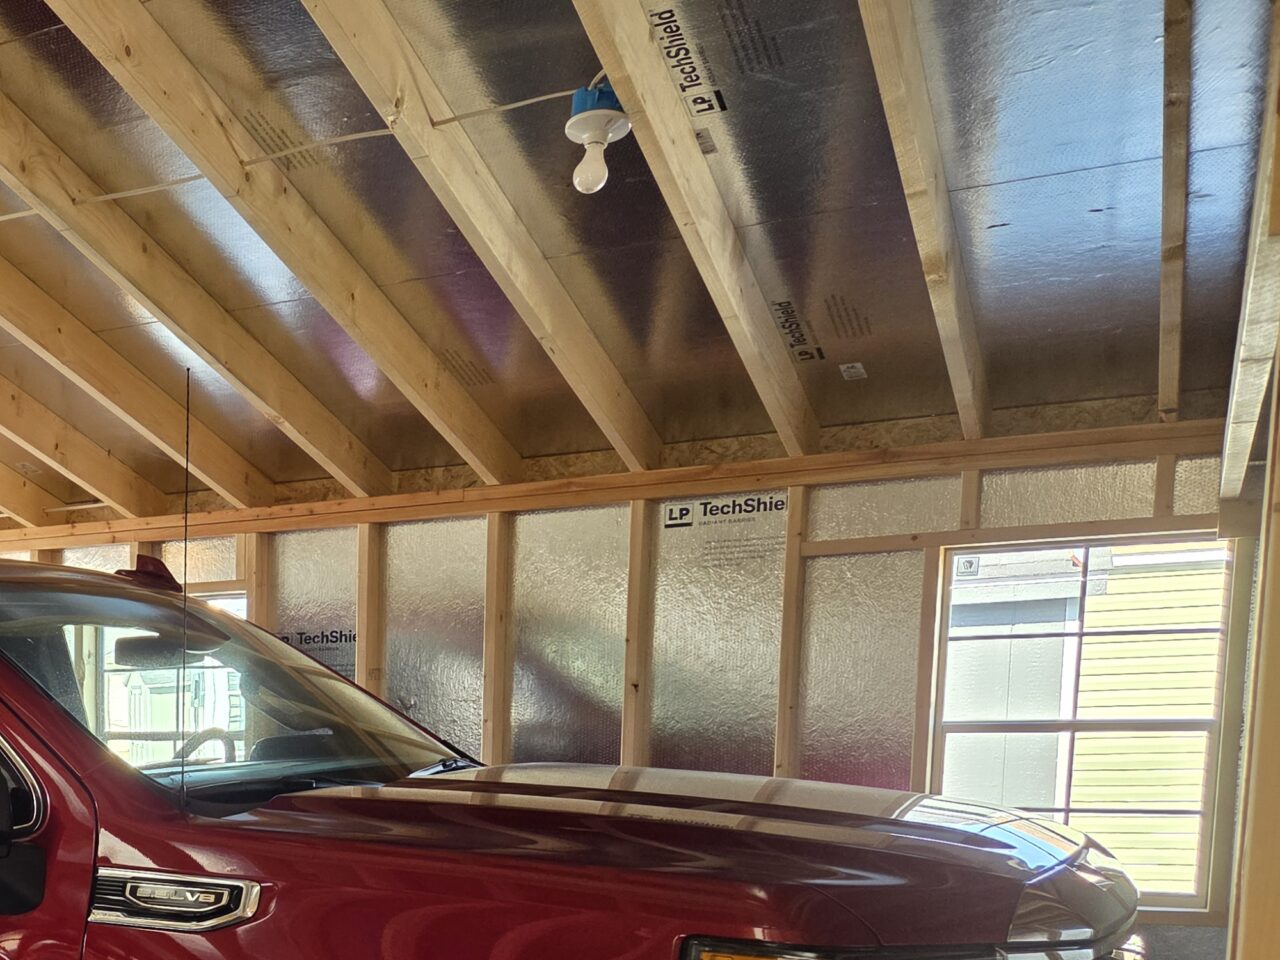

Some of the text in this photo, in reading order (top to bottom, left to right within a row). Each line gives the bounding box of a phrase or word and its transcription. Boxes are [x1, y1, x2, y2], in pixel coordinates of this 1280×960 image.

[649, 9, 702, 92] TechShield
[692, 96, 715, 113] LP
[772, 300, 808, 348] TechShield
[668, 507, 690, 521] LP
